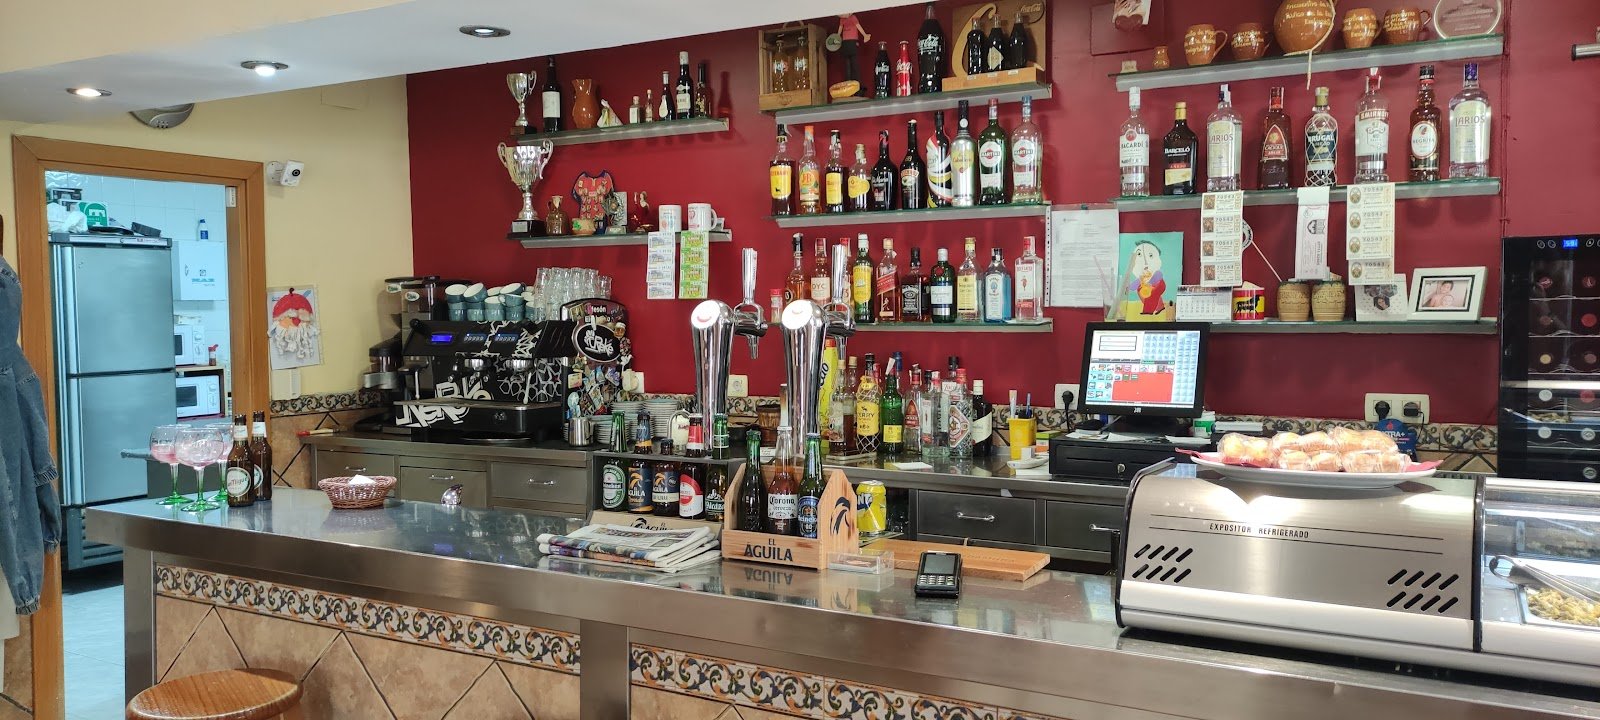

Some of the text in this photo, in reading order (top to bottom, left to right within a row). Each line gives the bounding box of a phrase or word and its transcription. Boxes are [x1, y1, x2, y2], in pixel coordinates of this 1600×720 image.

[1209, 522, 1309, 539] EXPOSITOR REFRIGERADO
[768, 538, 776, 546] EL
